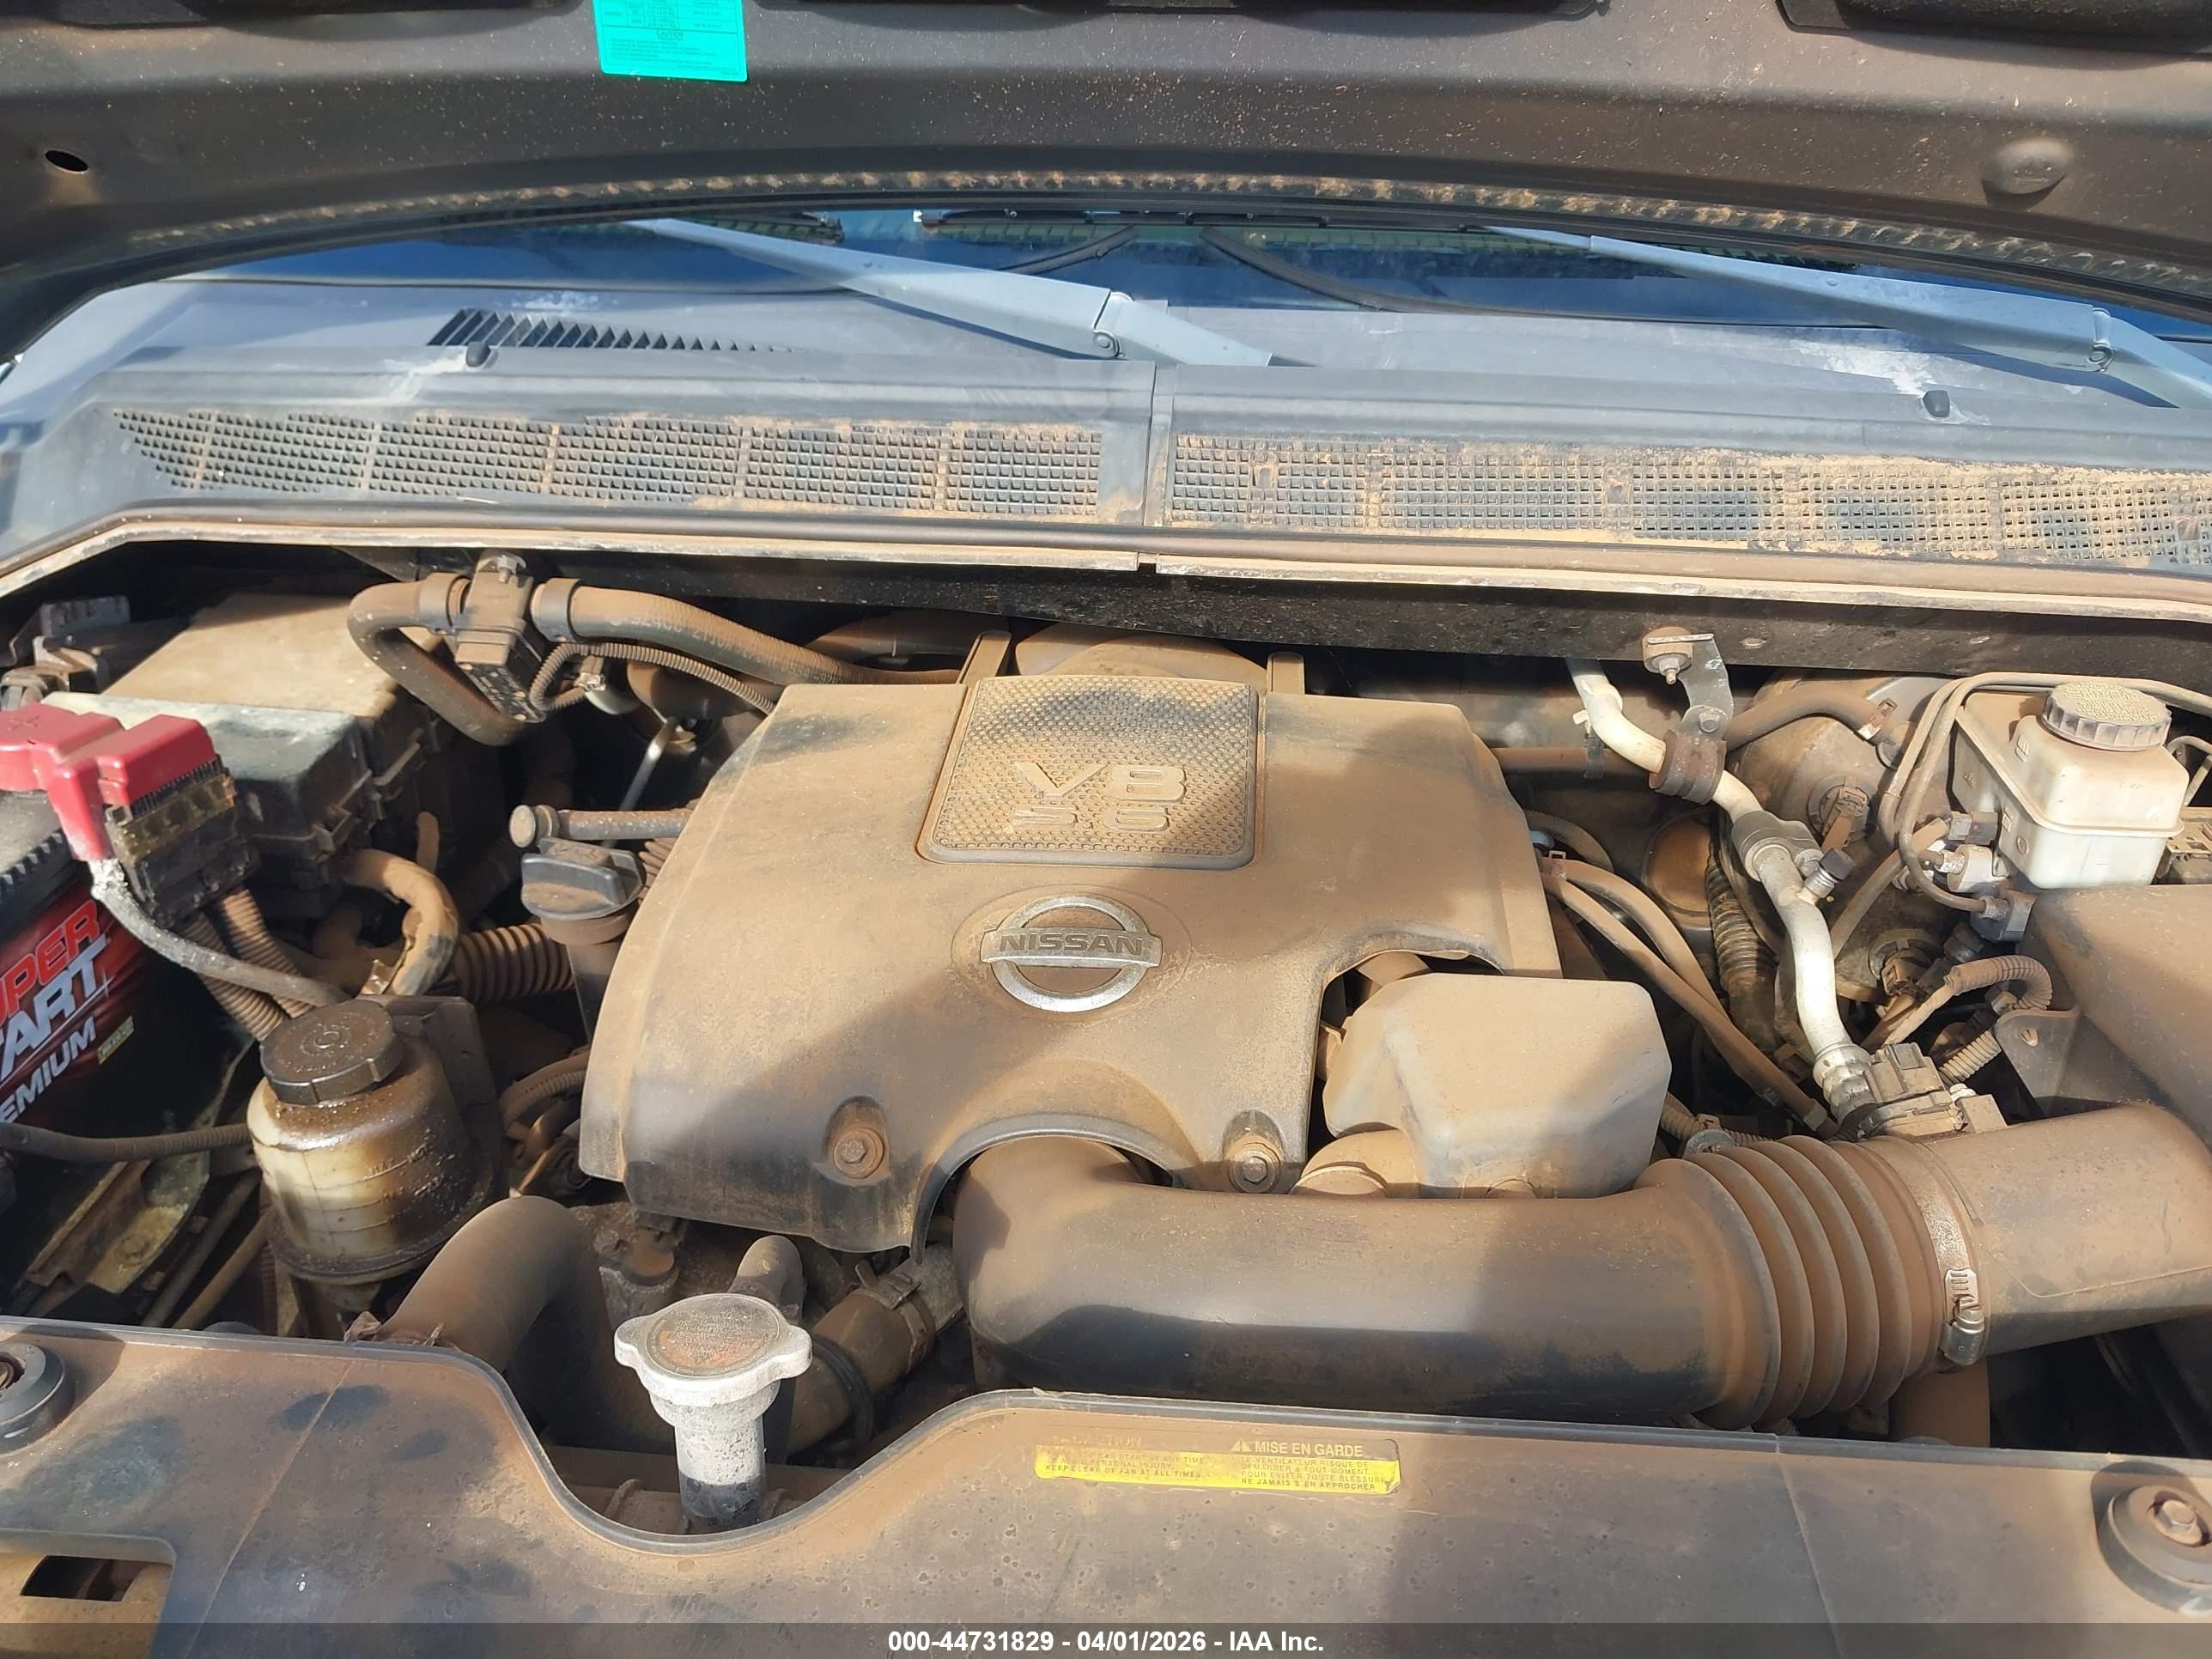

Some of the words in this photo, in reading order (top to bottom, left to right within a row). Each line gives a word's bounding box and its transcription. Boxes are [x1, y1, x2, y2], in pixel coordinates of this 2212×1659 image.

[1014, 762, 1188, 803] V8
[1012, 805, 1170, 832] 5.6
[1000, 933, 1143, 956] NISSAN
[0, 933, 106, 1080] ART
[1255, 1440, 1288, 1454] MISE
[1292, 1443, 1311, 1455] EN
[1315, 1443, 1364, 1457] GARDE
[1255, 1457, 1316, 1466] VENTILATEUR
[1319, 1481, 1376, 1490] APPROCHER
